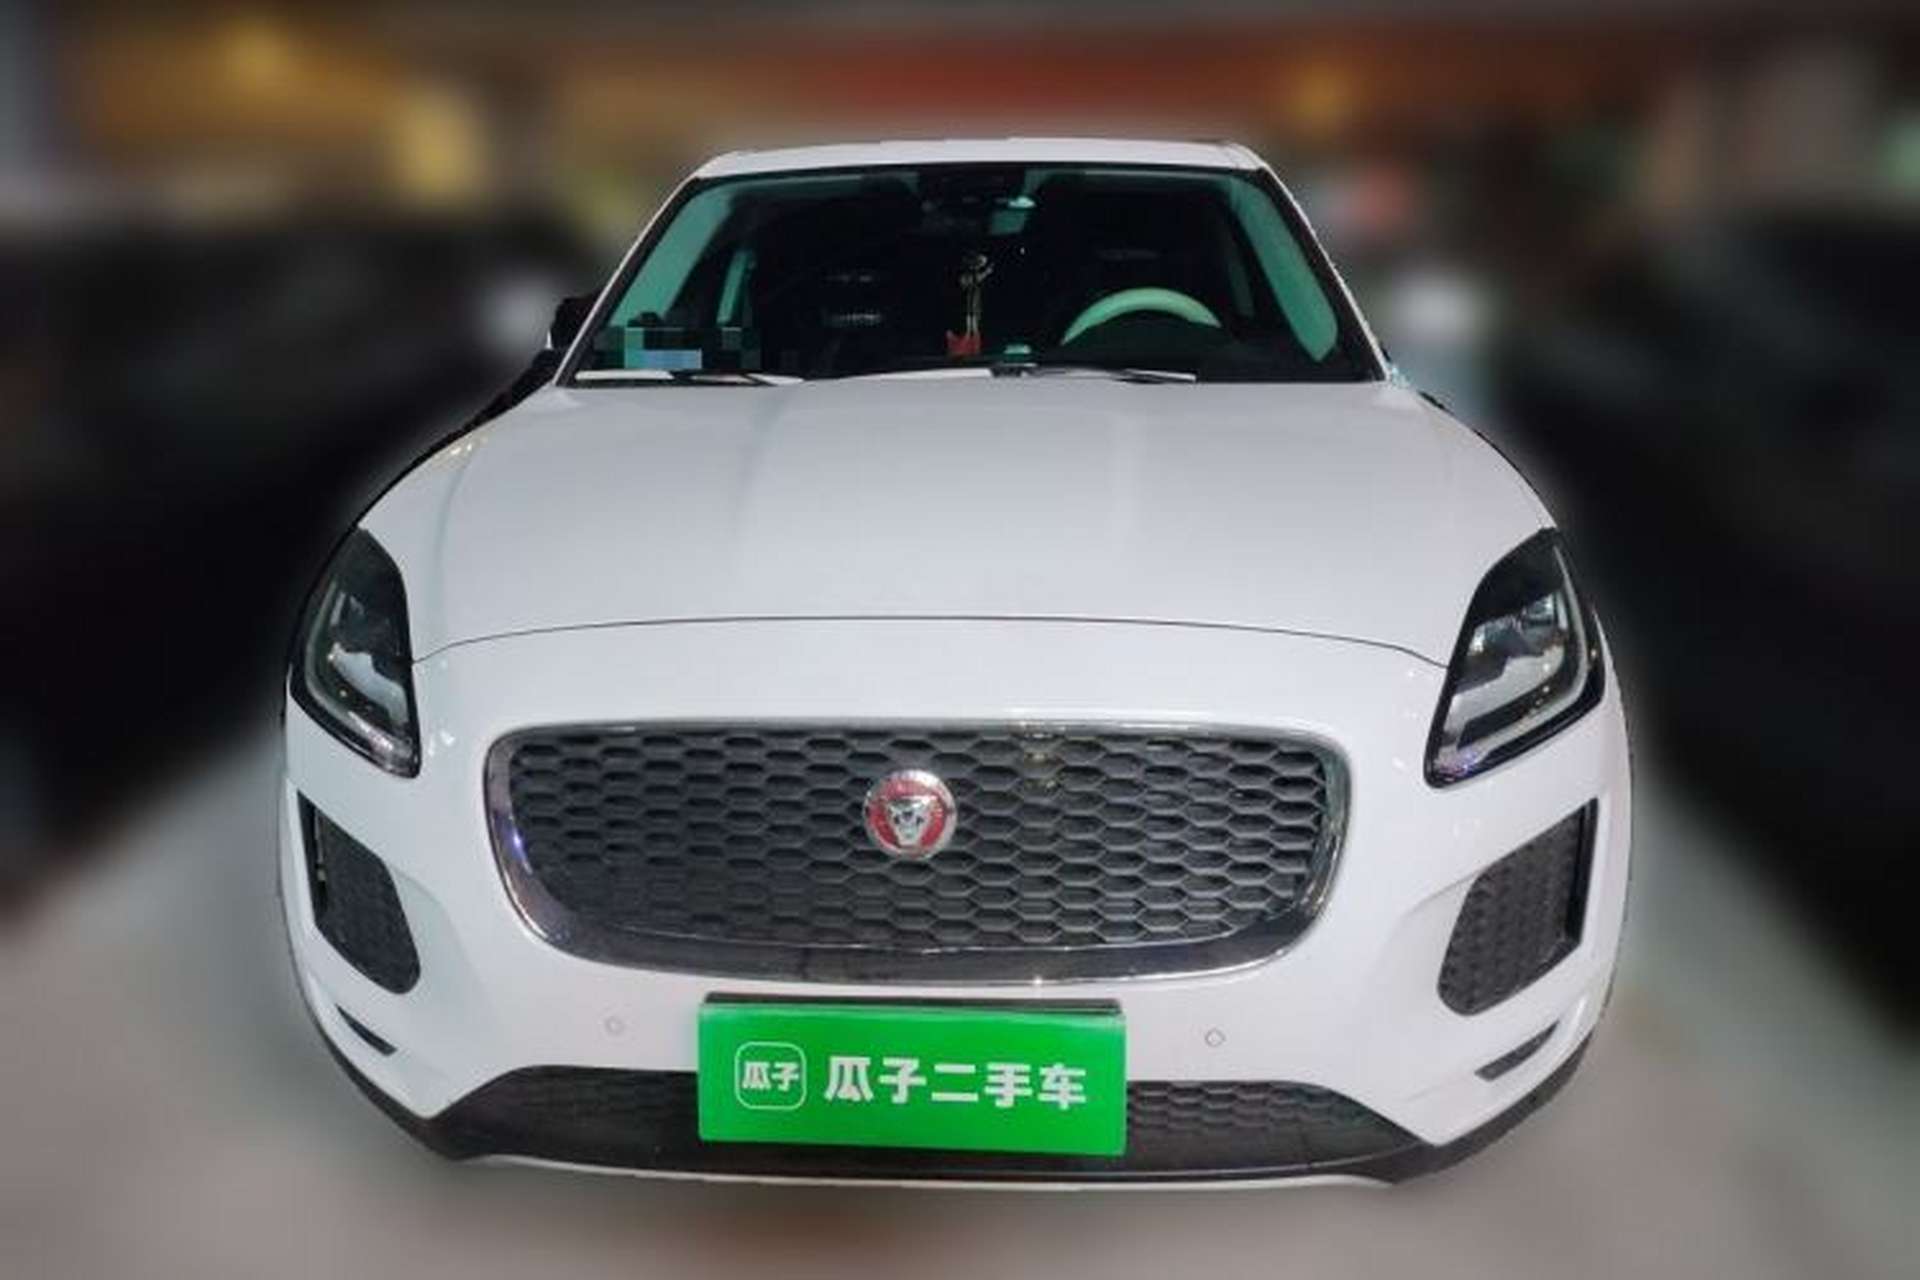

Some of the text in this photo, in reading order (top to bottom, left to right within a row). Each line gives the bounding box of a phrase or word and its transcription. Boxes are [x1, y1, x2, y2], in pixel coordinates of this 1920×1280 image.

[742, 1061, 800, 1091] 瓜子
[824, 1055, 1087, 1110] 瓜子二手车
